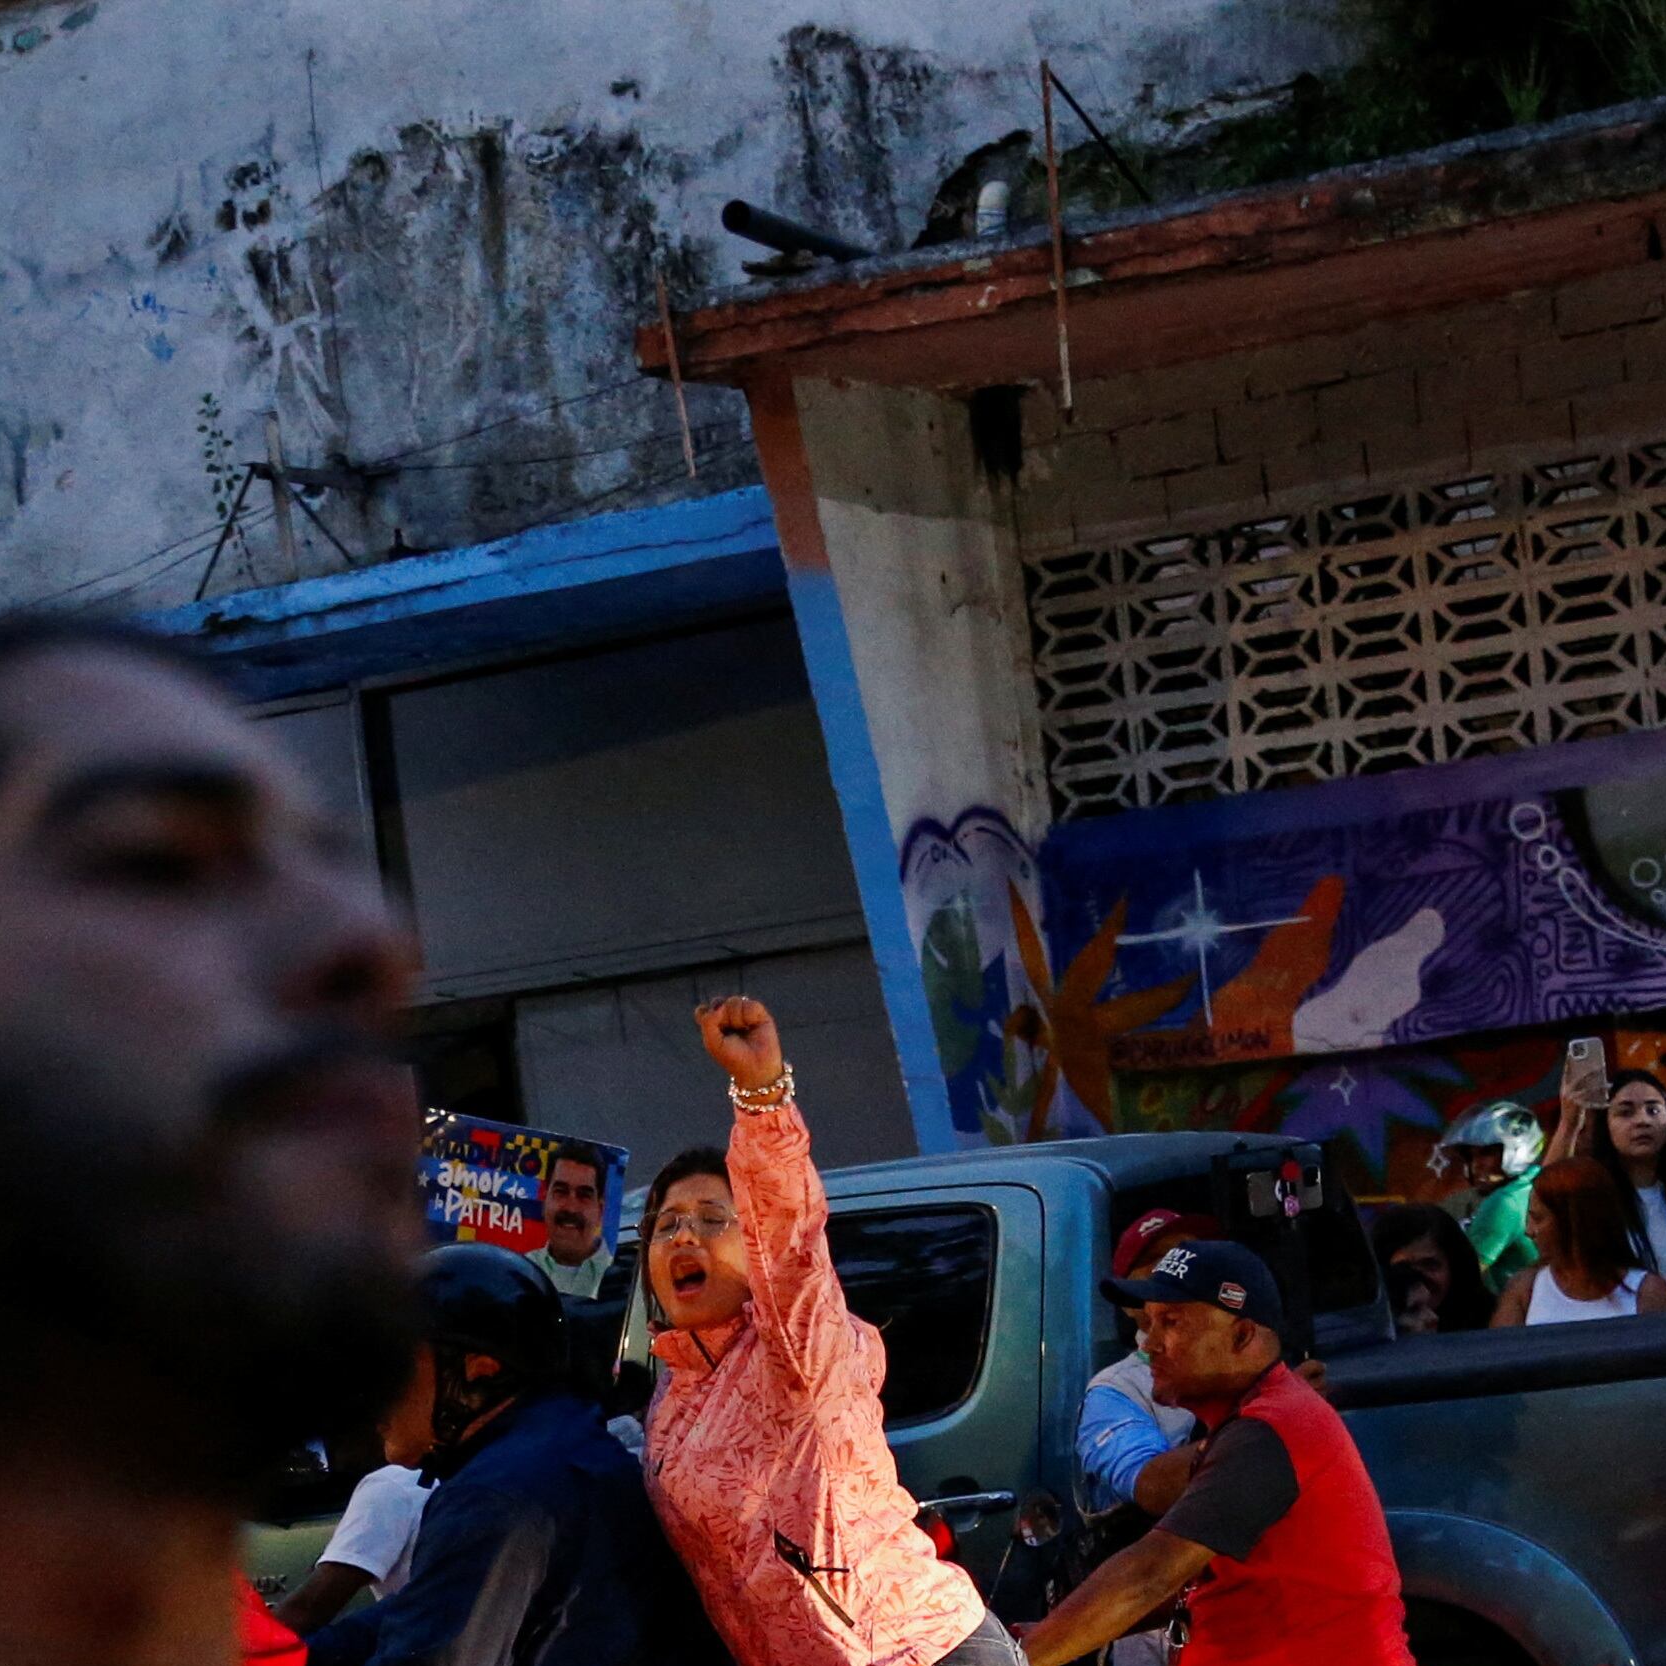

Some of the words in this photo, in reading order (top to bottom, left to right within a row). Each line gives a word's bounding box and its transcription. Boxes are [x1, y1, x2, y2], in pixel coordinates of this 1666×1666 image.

[437, 1161, 509, 1197] amor
[505, 1181, 529, 1199] de
[444, 1187, 524, 1236] PATRIA
